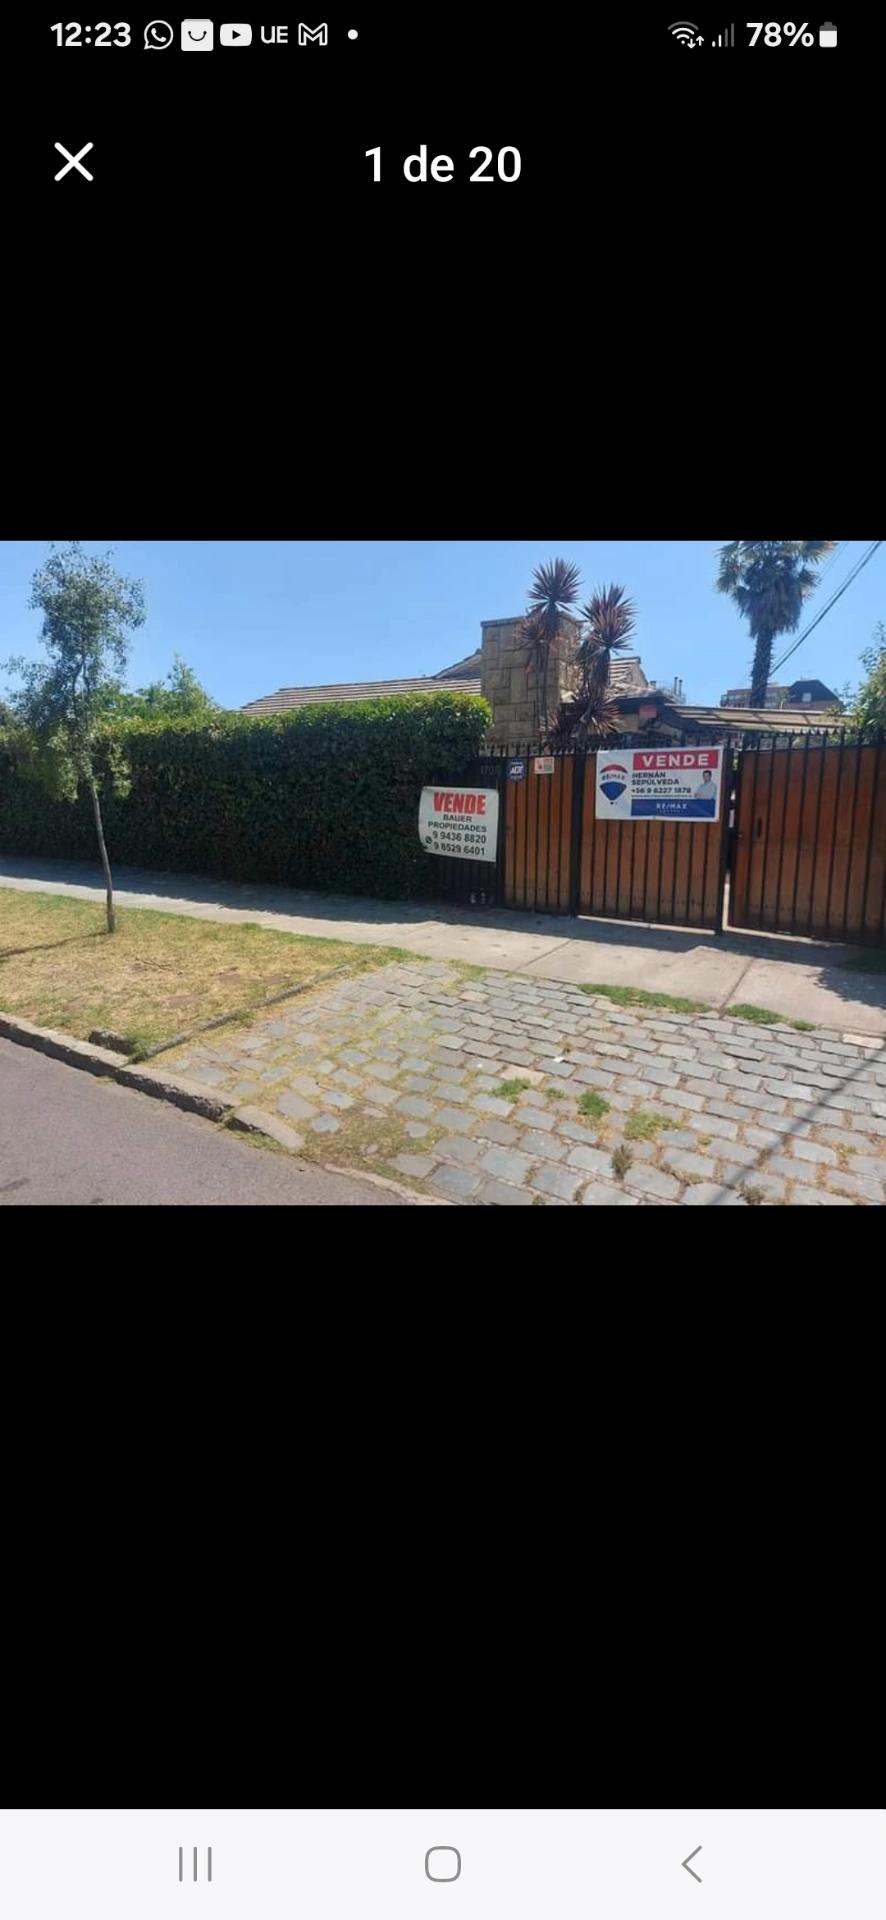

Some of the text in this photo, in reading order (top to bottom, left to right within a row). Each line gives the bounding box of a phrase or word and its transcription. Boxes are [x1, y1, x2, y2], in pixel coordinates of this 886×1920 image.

[642, 753, 710, 768] VENDE
[433, 792, 487, 815] VENDE
[443, 814, 473, 823] BAUER
[427, 821, 487, 833] PROPIEDADES
[440, 831, 462, 841] 9436
[464, 833, 487, 844] 8820
[463, 846, 485, 856] 6401
